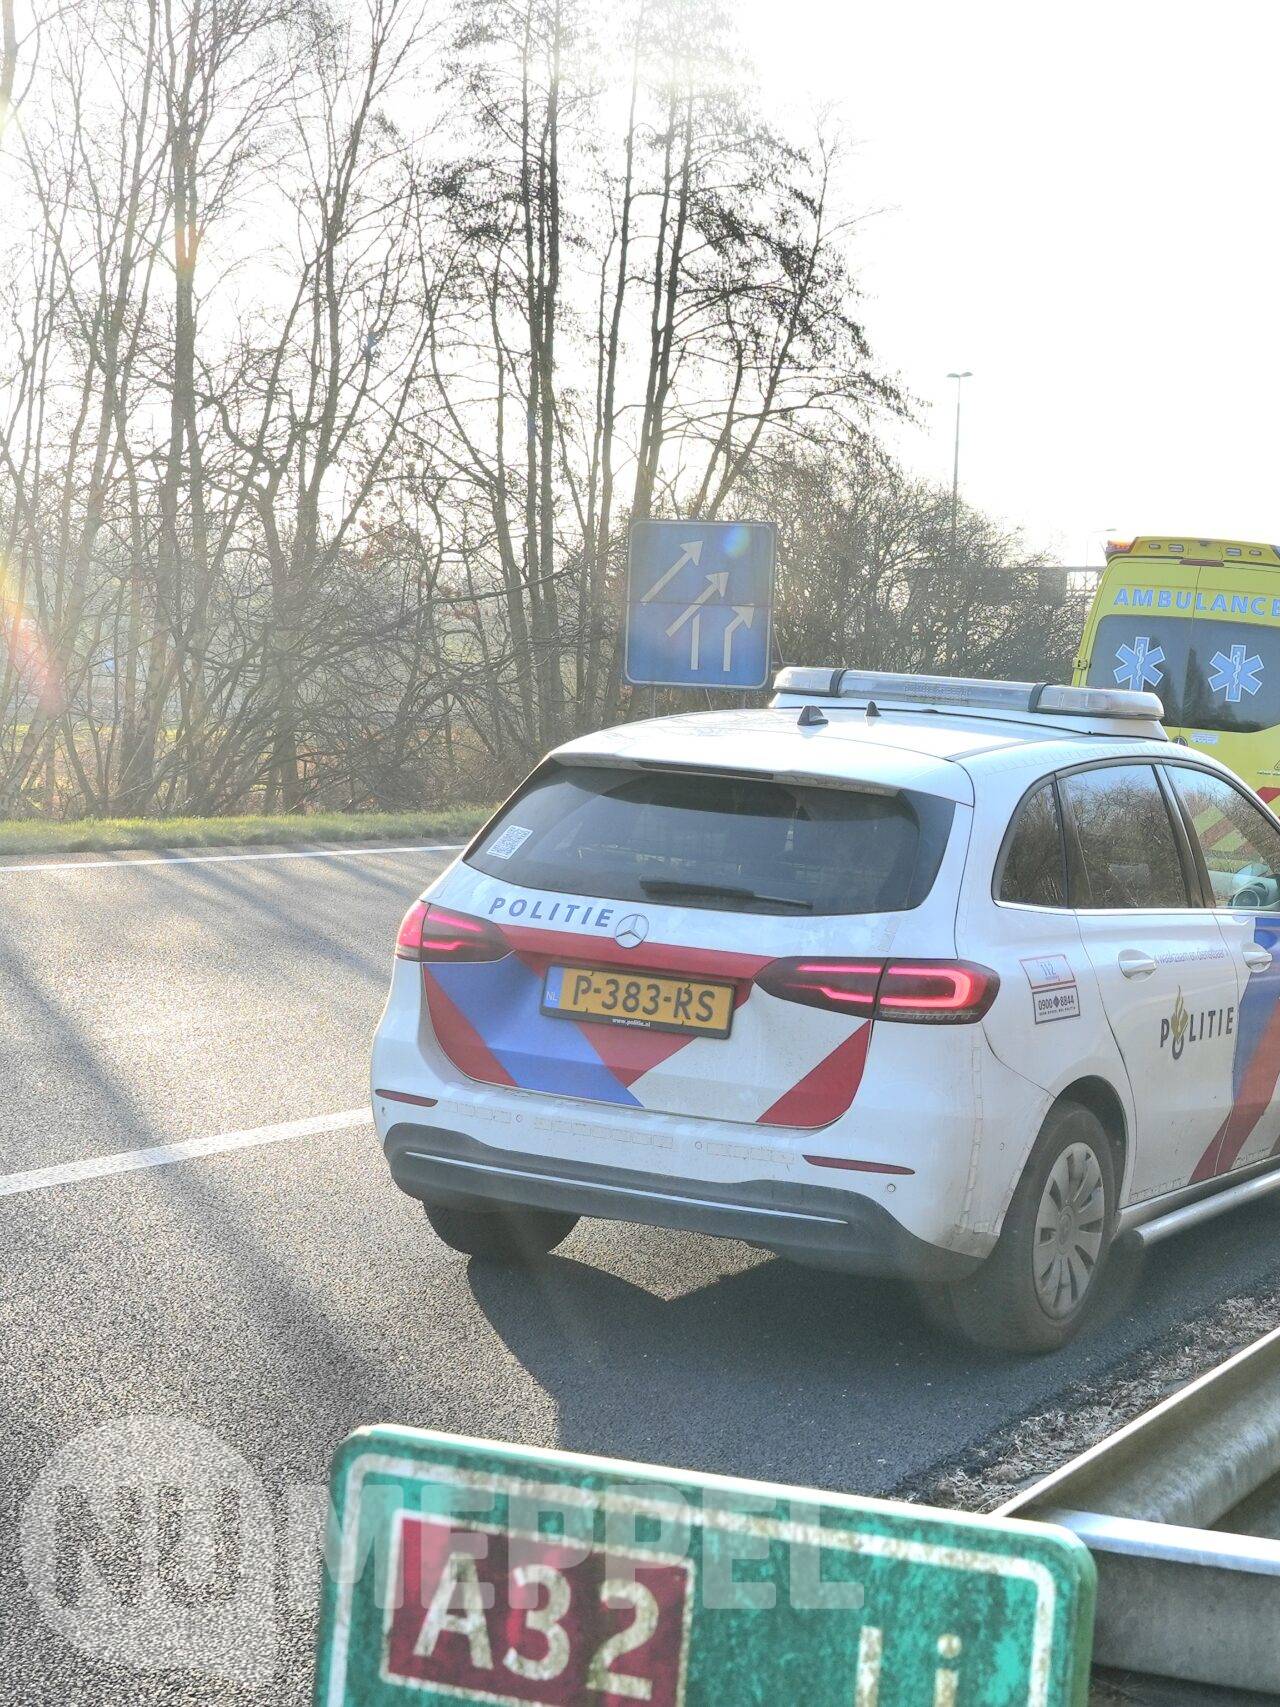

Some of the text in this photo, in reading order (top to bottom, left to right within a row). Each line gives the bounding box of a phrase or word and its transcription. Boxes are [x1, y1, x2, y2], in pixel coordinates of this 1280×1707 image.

[488, 897, 614, 928] POLITIE
[546, 991, 558, 1001] NL
[573, 975, 716, 1022] P-383-RS
[1038, 999, 1053, 1010] 0900
[612, 1018, 651, 1028] www.politie.nl
[1160, 1006, 1234, 1060] POLITIE
[413, 1553, 660, 1699] A32
